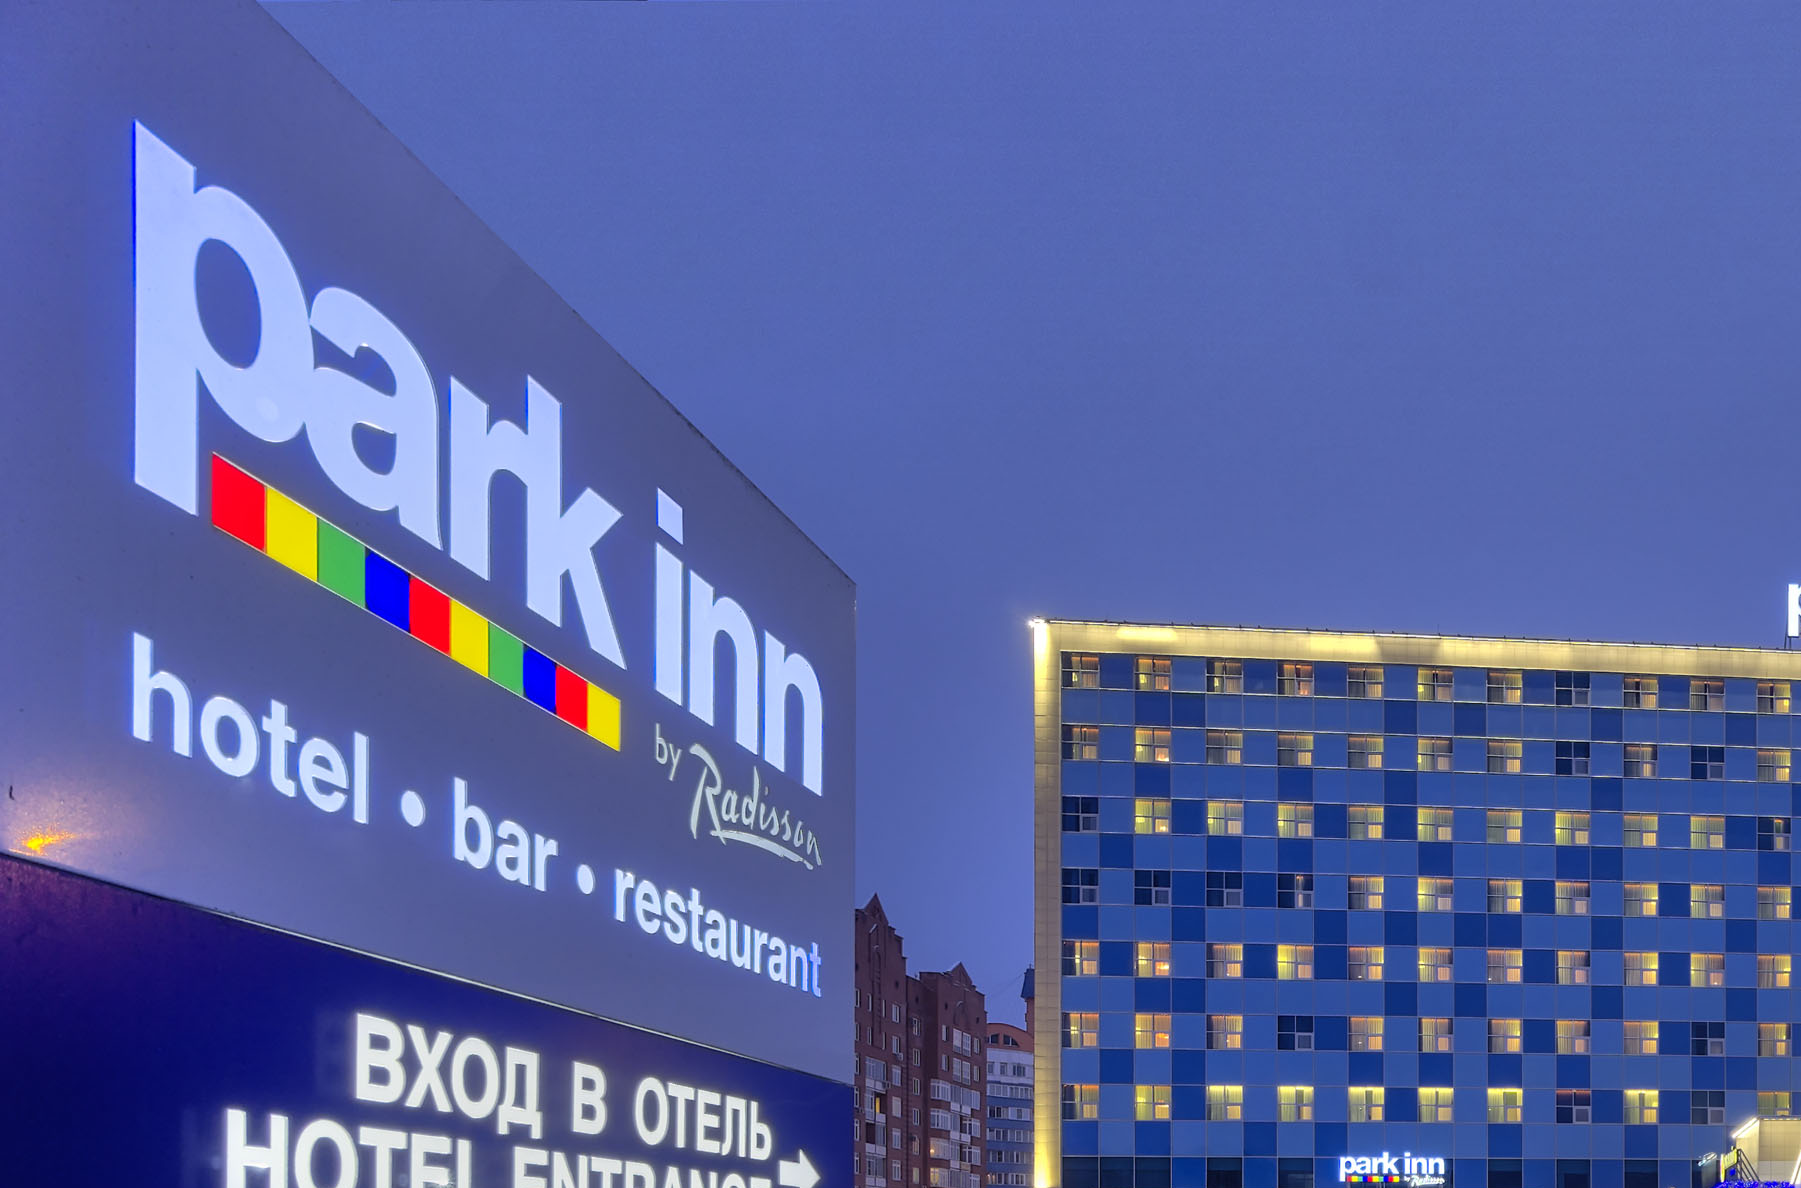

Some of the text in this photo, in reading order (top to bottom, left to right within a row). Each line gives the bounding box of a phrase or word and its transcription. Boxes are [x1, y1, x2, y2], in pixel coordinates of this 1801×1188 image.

[134, 120, 824, 797] park inn
[132, 632, 822, 998] hotel bar restaurant
[655, 723, 823, 870] by Radisson
[355, 1012, 773, 1161] ВХОД В ОТЕЛЬ
[1339, 1151, 1445, 1182] park inn
